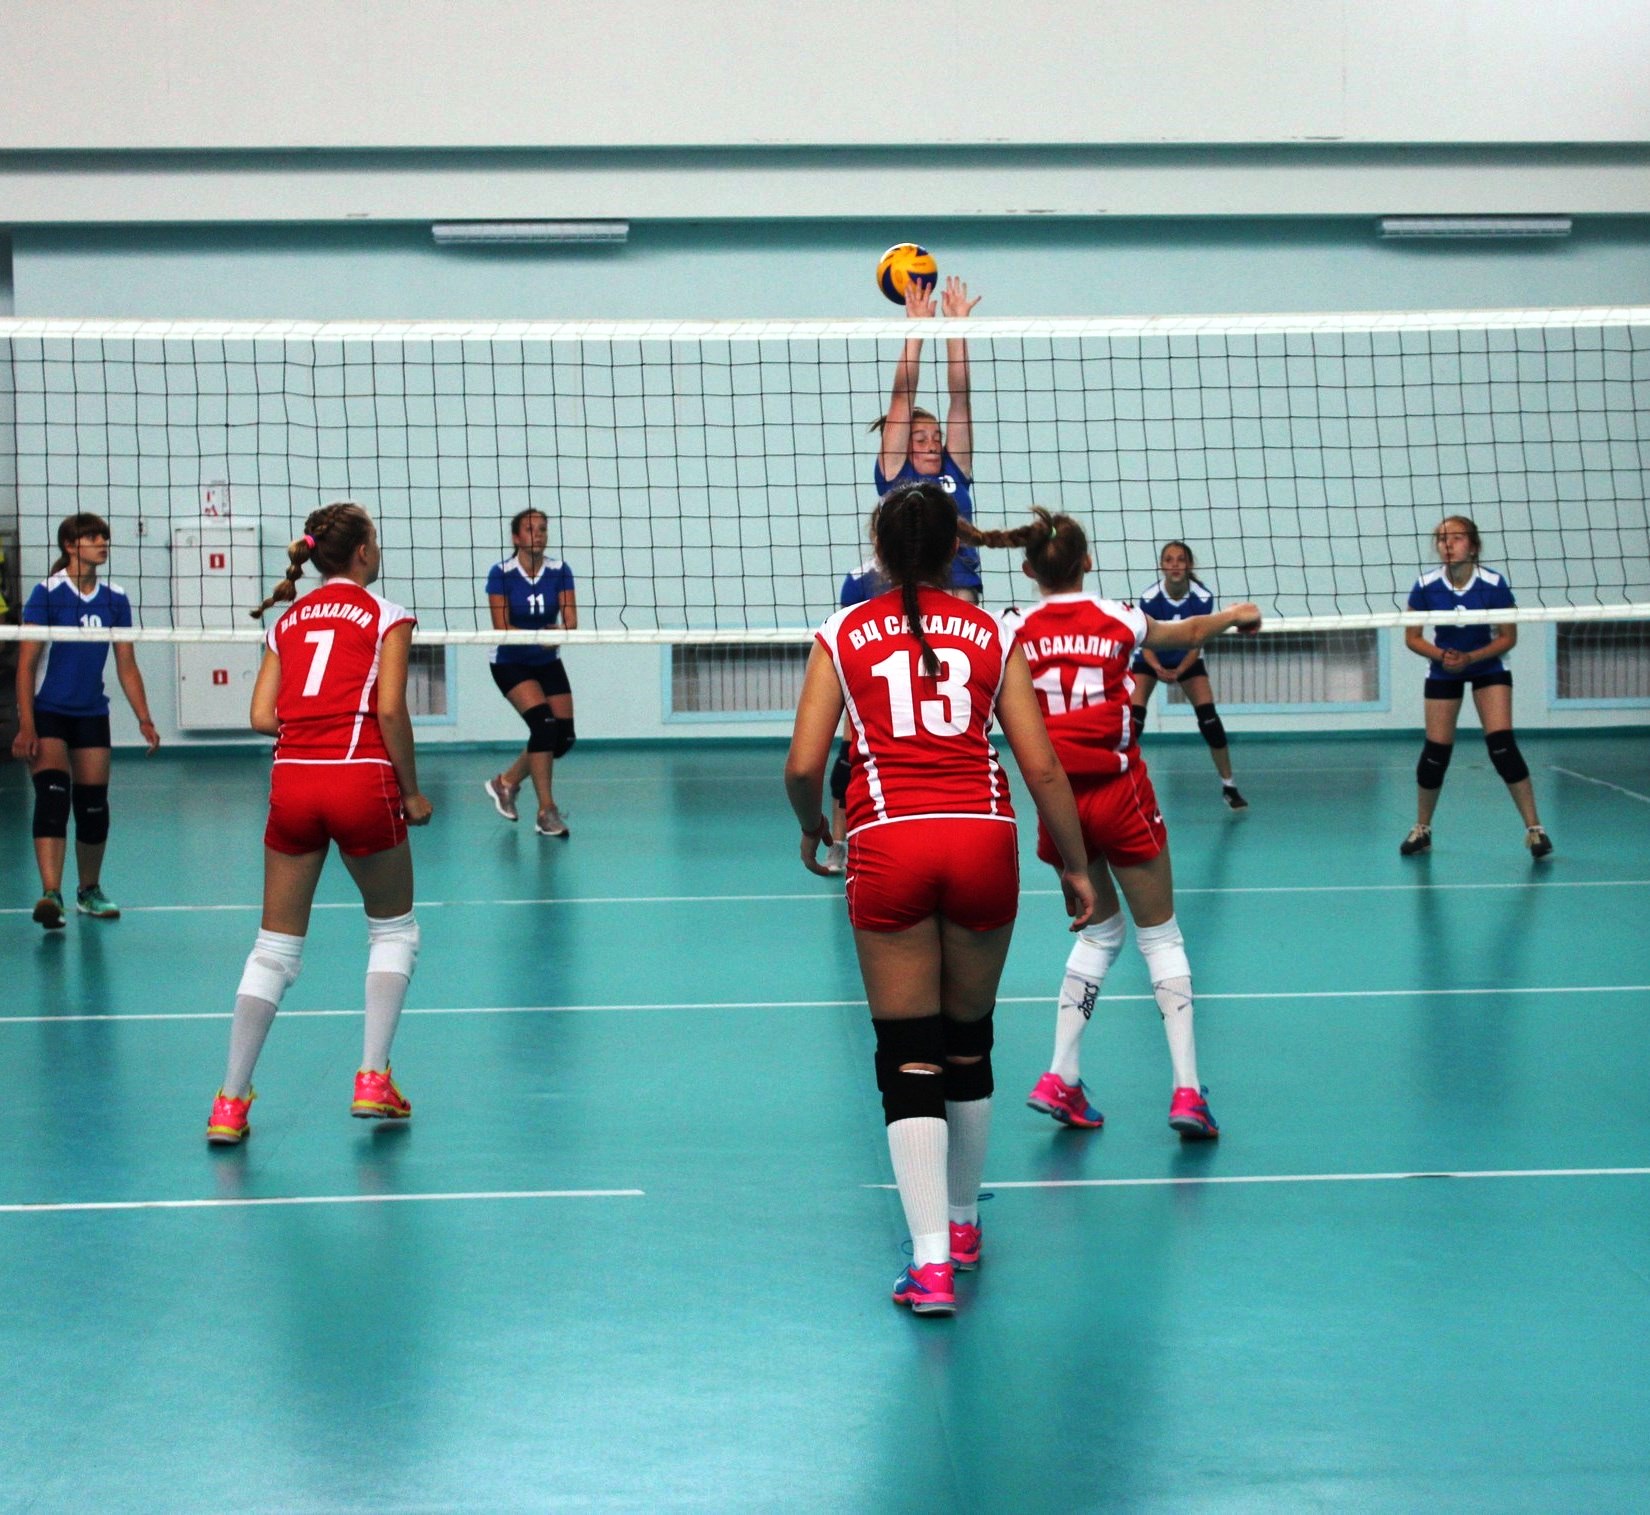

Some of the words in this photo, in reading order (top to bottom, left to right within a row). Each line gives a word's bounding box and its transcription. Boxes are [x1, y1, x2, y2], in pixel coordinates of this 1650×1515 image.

[80, 613, 102, 628] 10
[300, 603, 373, 629] САХАЛИН
[527, 593, 545, 615] 11
[848, 619, 882, 650] ВЦ
[302, 629, 335, 697] 7
[871, 647, 972, 738] 13
[1032, 666, 1106, 716] 14
[1077, 981, 1100, 1020] asics
